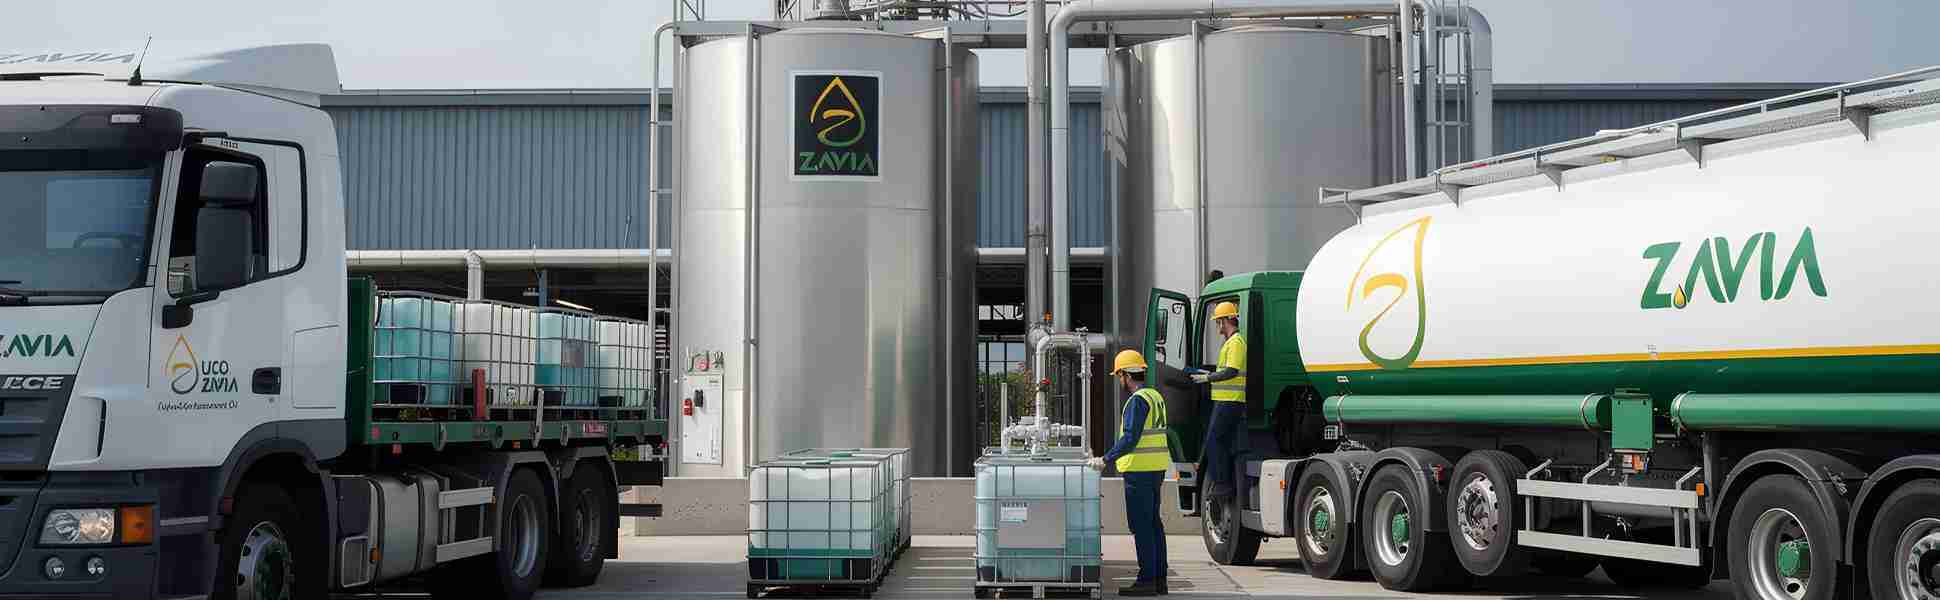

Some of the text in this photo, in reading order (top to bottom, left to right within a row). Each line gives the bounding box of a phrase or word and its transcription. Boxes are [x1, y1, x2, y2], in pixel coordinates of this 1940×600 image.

[799, 151, 874, 171] ZAVIA
[1641, 226, 1828, 309] ZAVIA
[0, 334, 75, 357] AVIA
[201, 360, 229, 375] UCO
